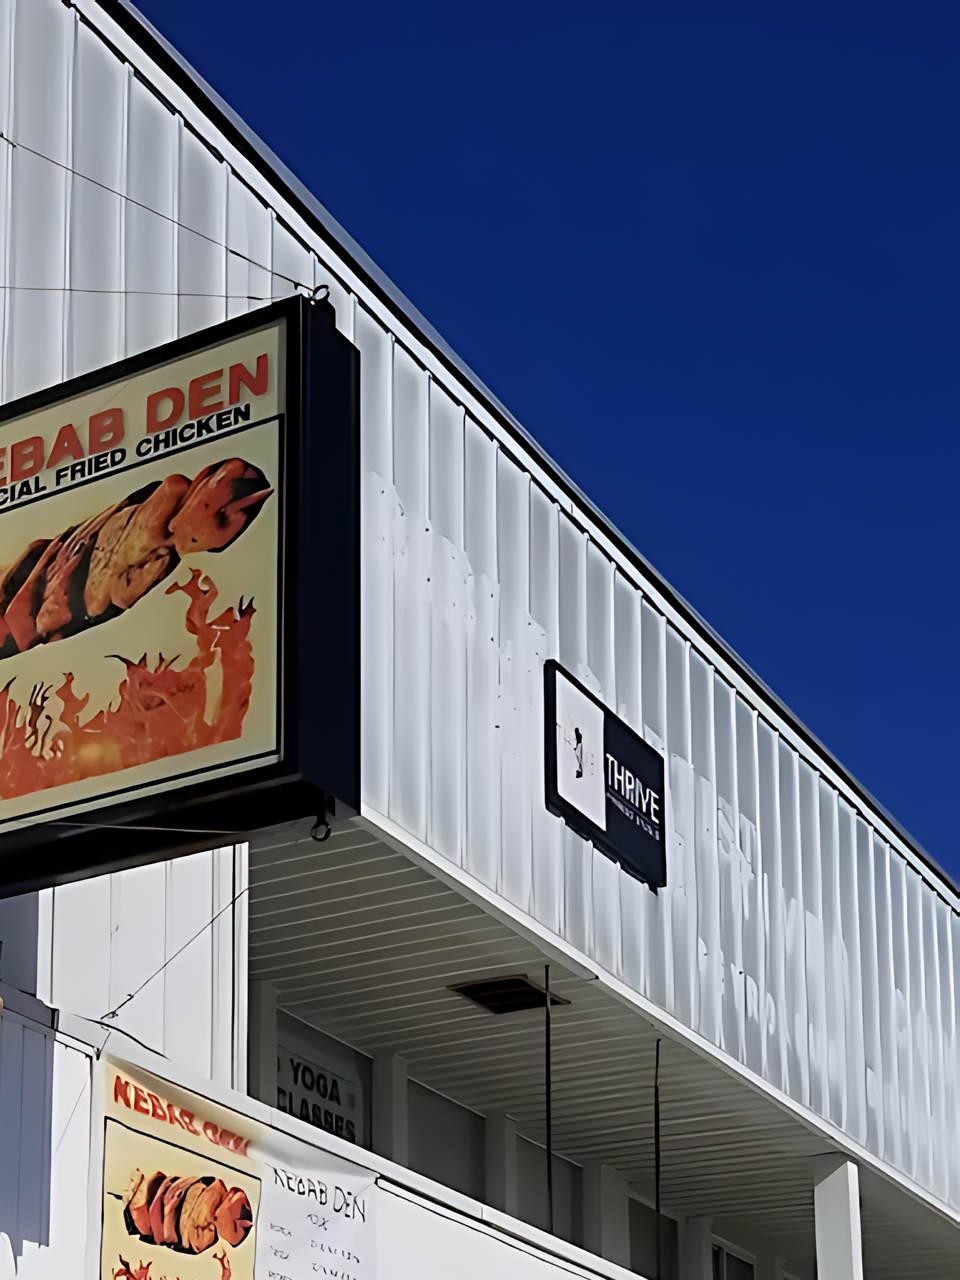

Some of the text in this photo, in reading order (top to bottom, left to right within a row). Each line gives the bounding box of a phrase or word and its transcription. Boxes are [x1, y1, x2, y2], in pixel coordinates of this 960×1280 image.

[146, 354, 268, 434] DEN
[55, 448, 126, 487] FRIED
[136, 404, 251, 458] CHICKEN
[606, 753, 660, 824] THRIVE
[289, 1058, 342, 1106] YOGA
[333, 1185, 366, 1224] DEN
